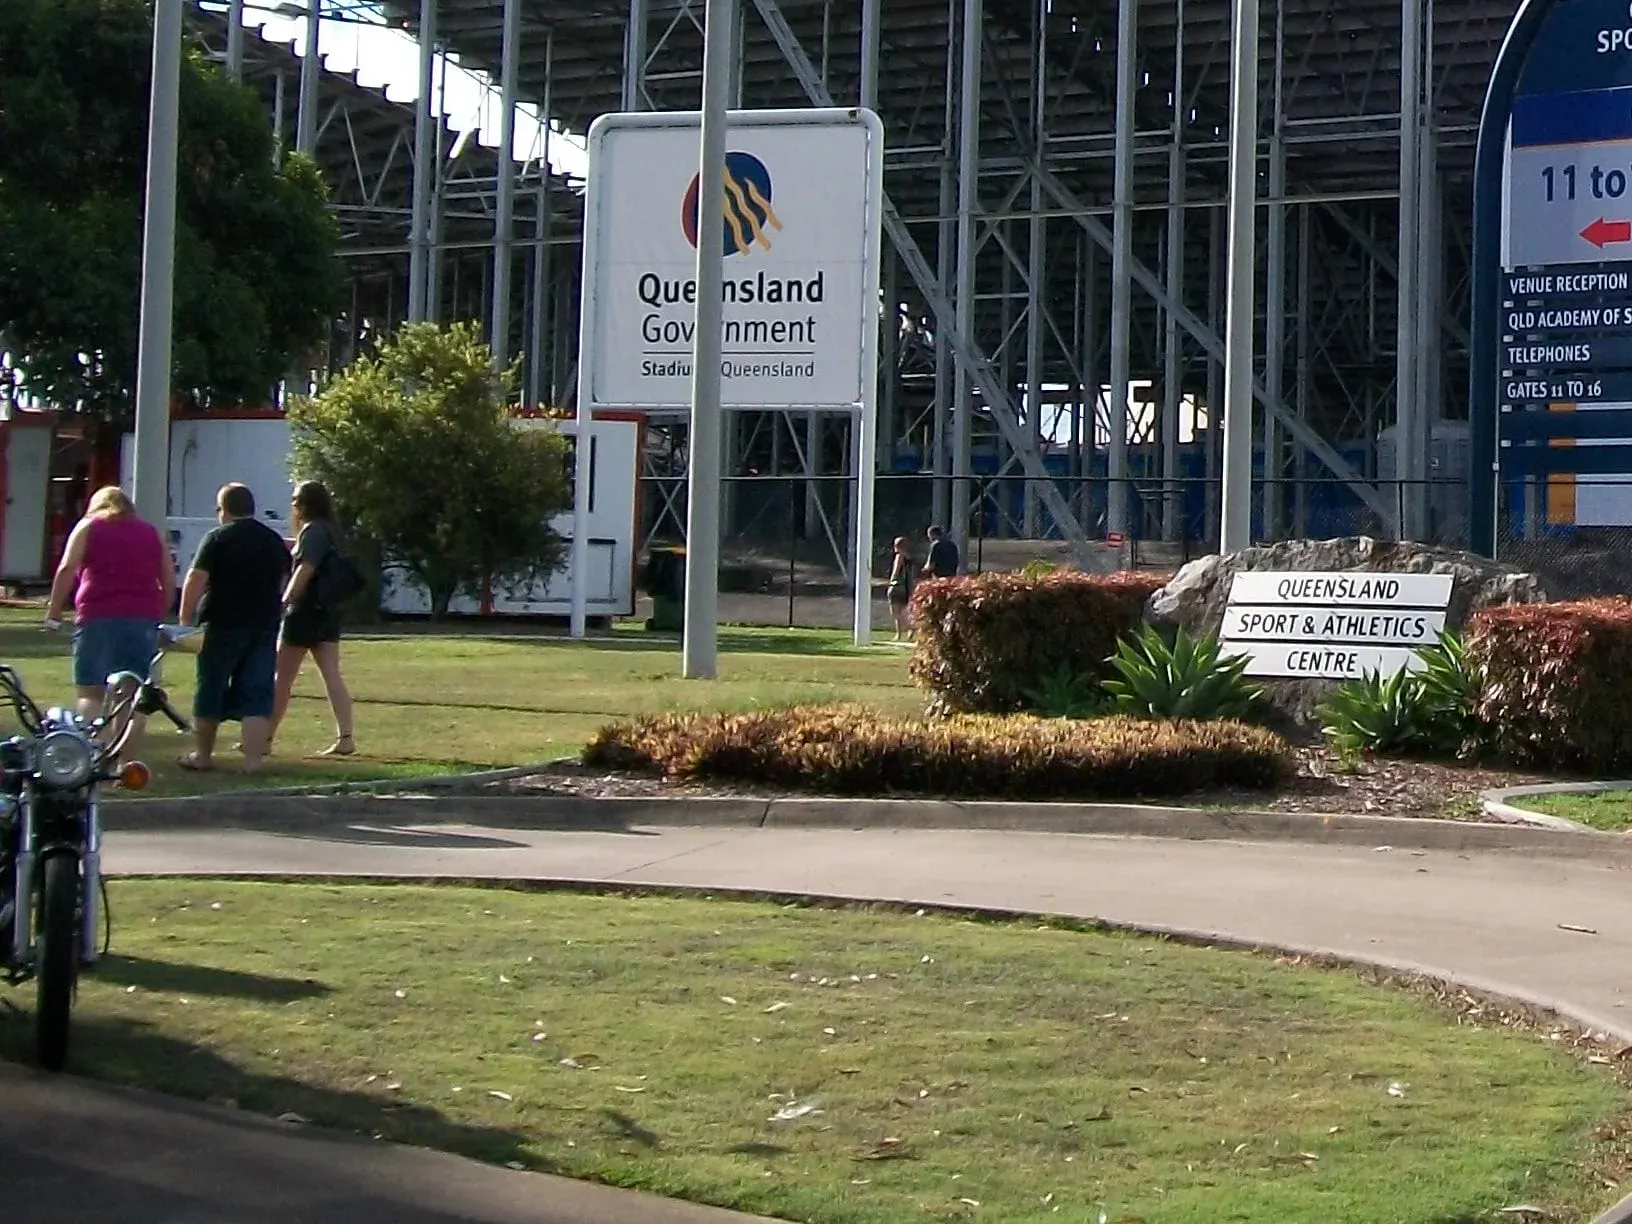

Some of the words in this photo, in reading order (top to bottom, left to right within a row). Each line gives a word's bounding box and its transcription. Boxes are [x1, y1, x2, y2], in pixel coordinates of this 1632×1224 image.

[1541, 166, 1577, 202] 11
[638, 271, 824, 307] Quensland
[1509, 276, 1552, 295] VENUE
[1556, 273, 1628, 293] RECEPTION
[642, 314, 817, 343] Govnment
[1508, 312, 1534, 331] QLD
[1538, 309, 1600, 328] ACADEMY
[1603, 308, 1621, 326] OF
[1508, 345, 1590, 364] TELEPHONES
[641, 361, 695, 377] Stadiu
[721, 361, 814, 378] Queensland
[1507, 381, 1547, 398] GATES
[1551, 384, 1564, 398] 11
[1567, 381, 1584, 396] TO
[1587, 380, 1602, 396] 16
[1277, 579, 1399, 600] QUEENSLAND
[1238, 614, 1299, 633] SPORT
[1302, 616, 1315, 634] &
[1321, 616, 1426, 638] ATHLETICS
[1286, 650, 1358, 672] CENTRE
